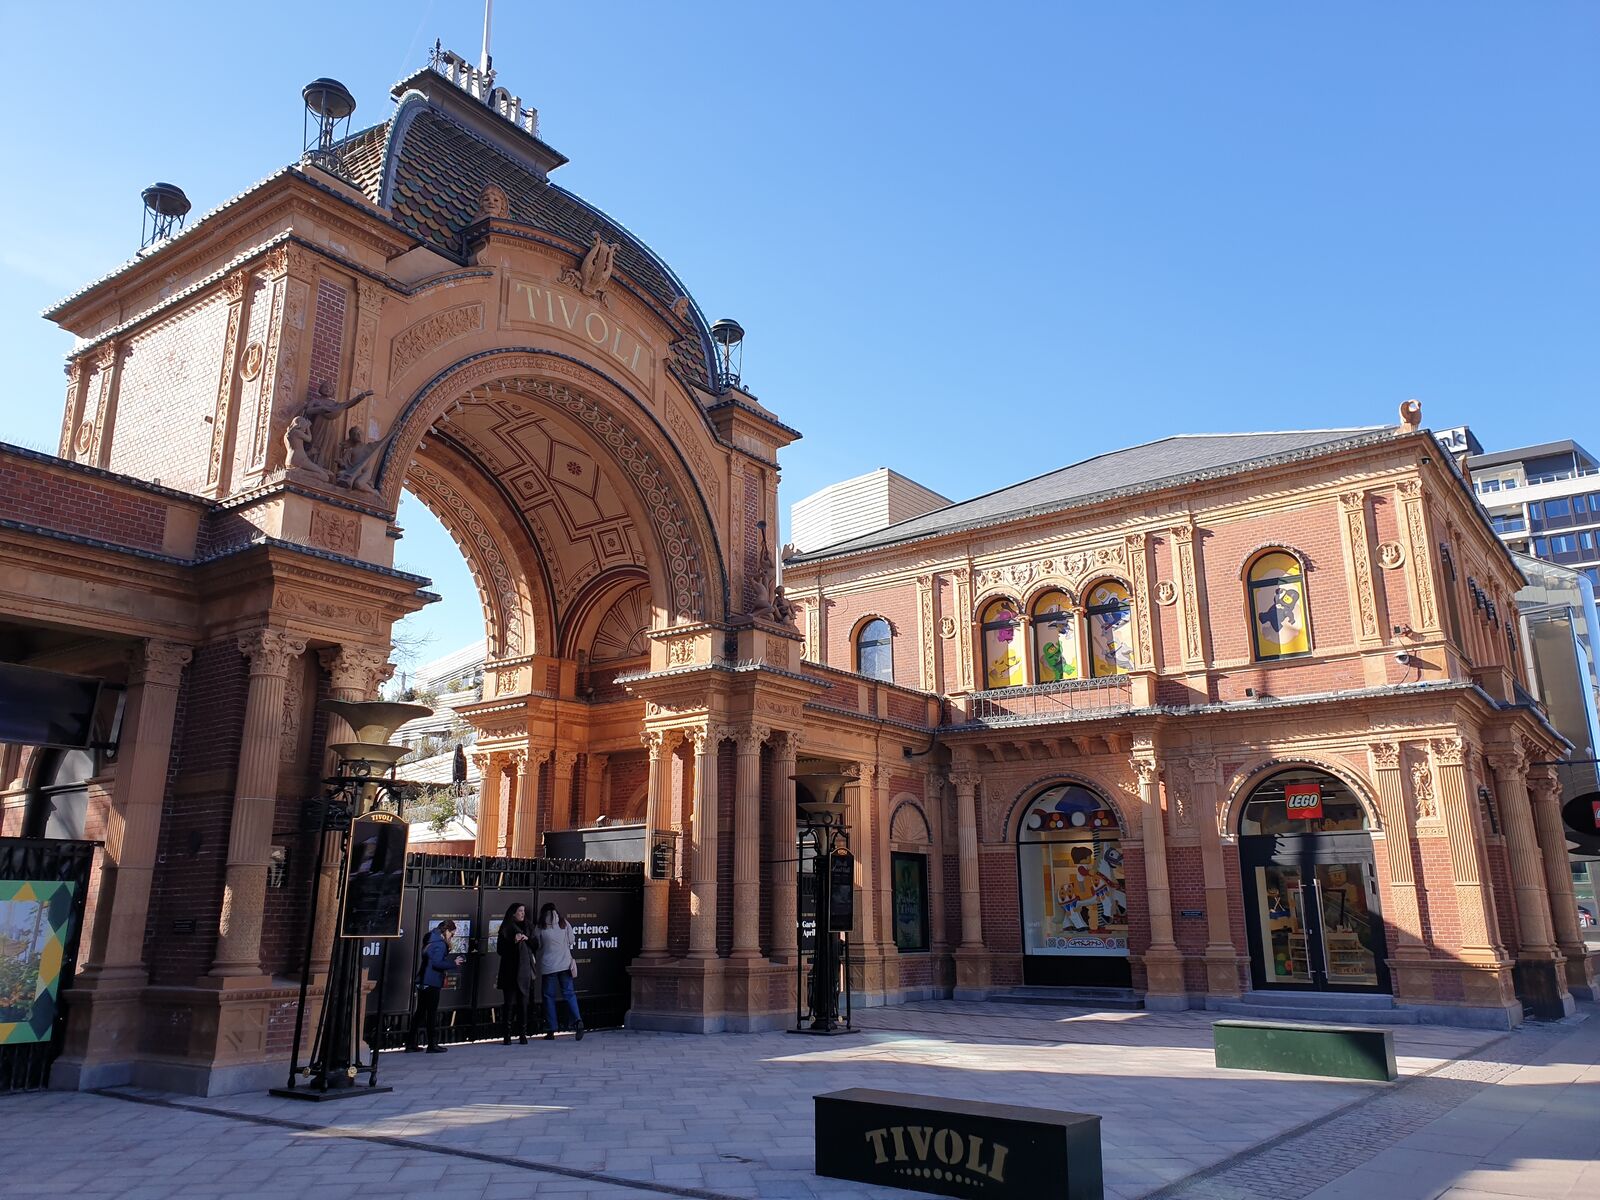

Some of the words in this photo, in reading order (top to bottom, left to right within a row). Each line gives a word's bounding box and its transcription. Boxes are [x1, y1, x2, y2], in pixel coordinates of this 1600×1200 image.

[516, 283, 641, 371] TIVOLI
[1288, 794, 1319, 808] LEGO
[371, 814, 393, 822] TIVOLI
[572, 923, 609, 935] erience
[802, 928, 816, 938] April
[362, 942, 380, 956] oli
[578, 938, 588, 949] in
[589, 937, 618, 949] Tivoli
[865, 1126, 1008, 1182] TIVOLI
